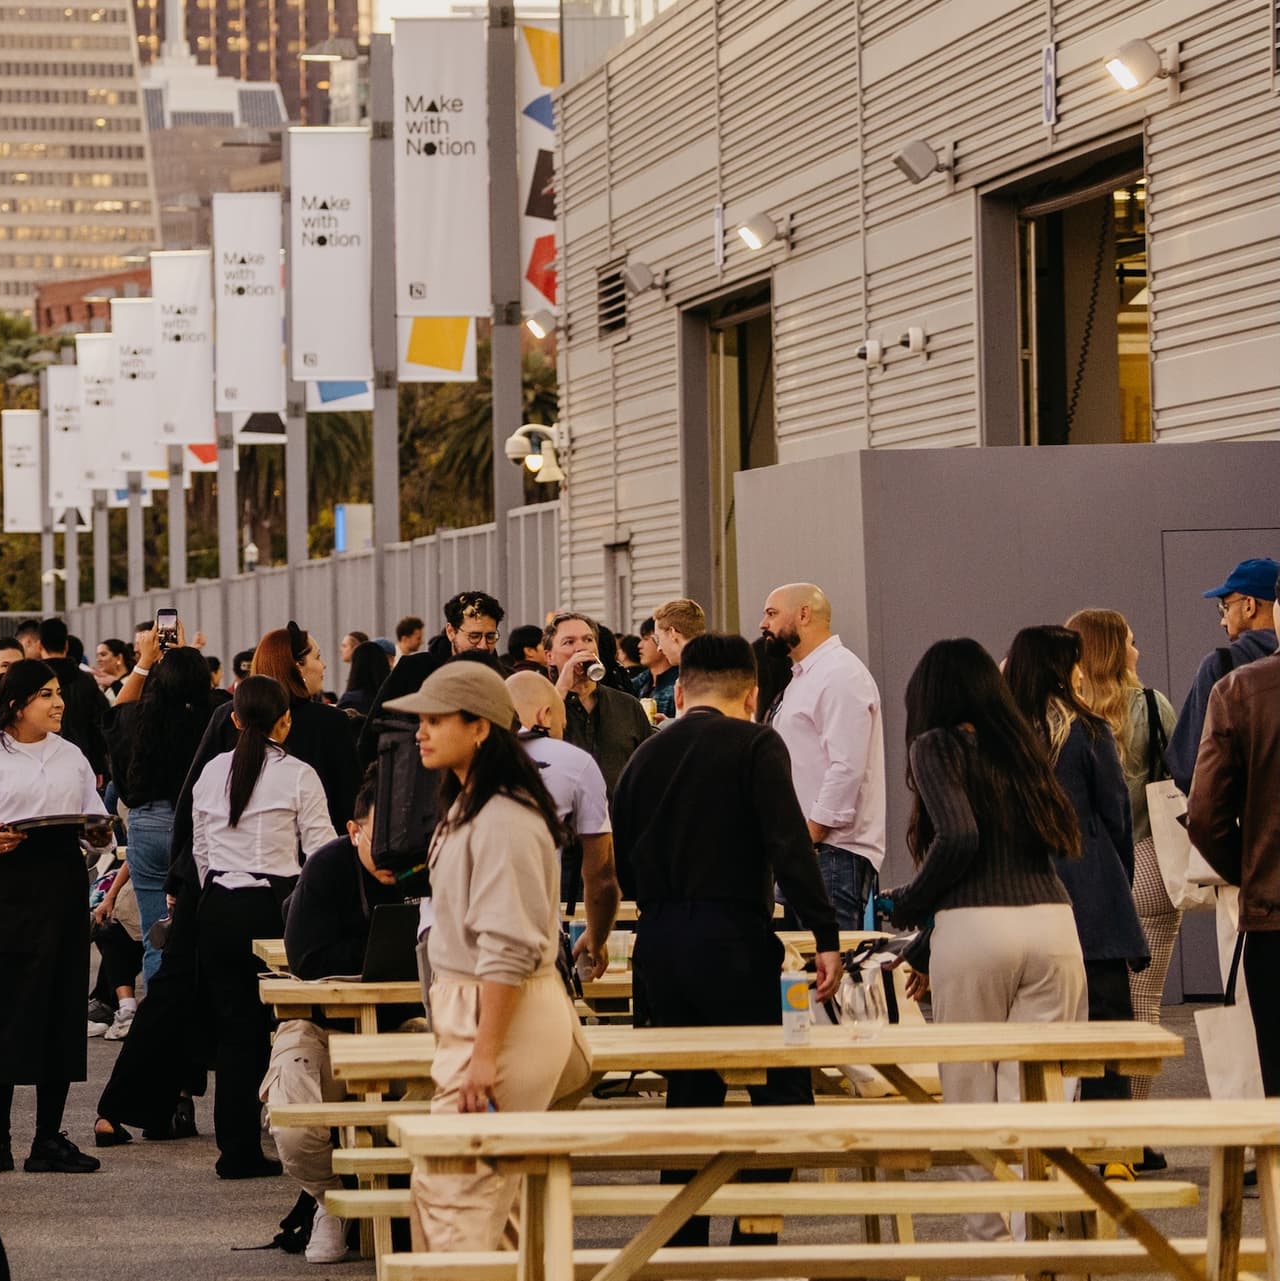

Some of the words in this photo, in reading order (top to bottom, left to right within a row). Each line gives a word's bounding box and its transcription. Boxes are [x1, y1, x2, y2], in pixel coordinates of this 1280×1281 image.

[405, 95, 464, 113] Make
[406, 115, 449, 134] with
[406, 137, 476, 156] Notion
[301, 214, 338, 228] with
[223, 268, 256, 281] with
